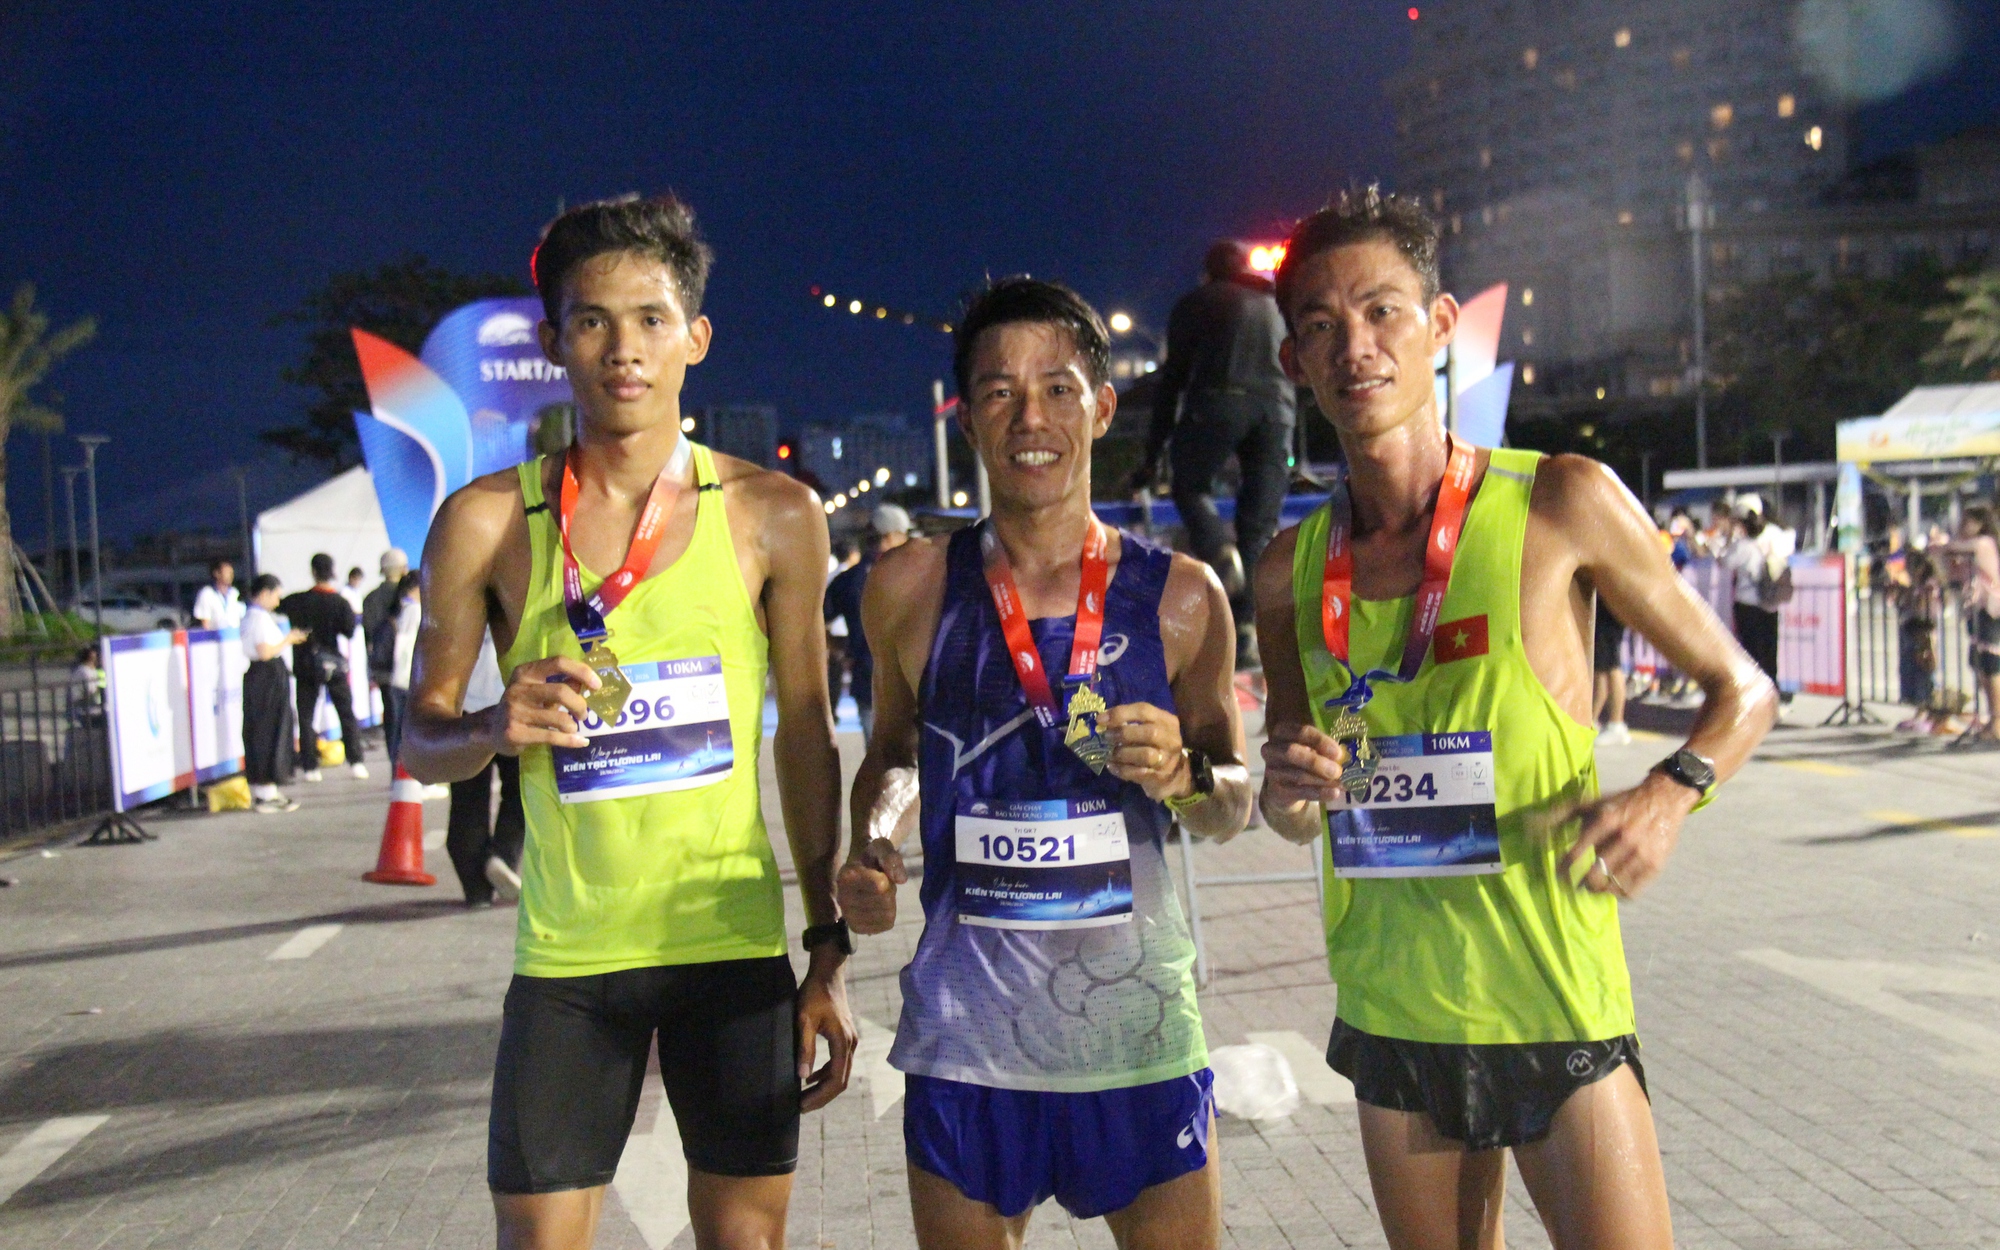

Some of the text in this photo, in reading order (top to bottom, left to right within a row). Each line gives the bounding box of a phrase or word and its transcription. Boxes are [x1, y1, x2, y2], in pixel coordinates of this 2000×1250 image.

[666, 661, 703, 675] 10KM
[1431, 736, 1470, 750] 10KM
[563, 752, 662, 773] KIẾN TẠO TƯƠNG LAI
[1075, 799, 1106, 814] 10KM
[1405, 835, 1421, 843] LAI
[979, 834, 1075, 862] 10521
[965, 887, 1062, 900] KIẾN TẠO TƯƠNG LAI
